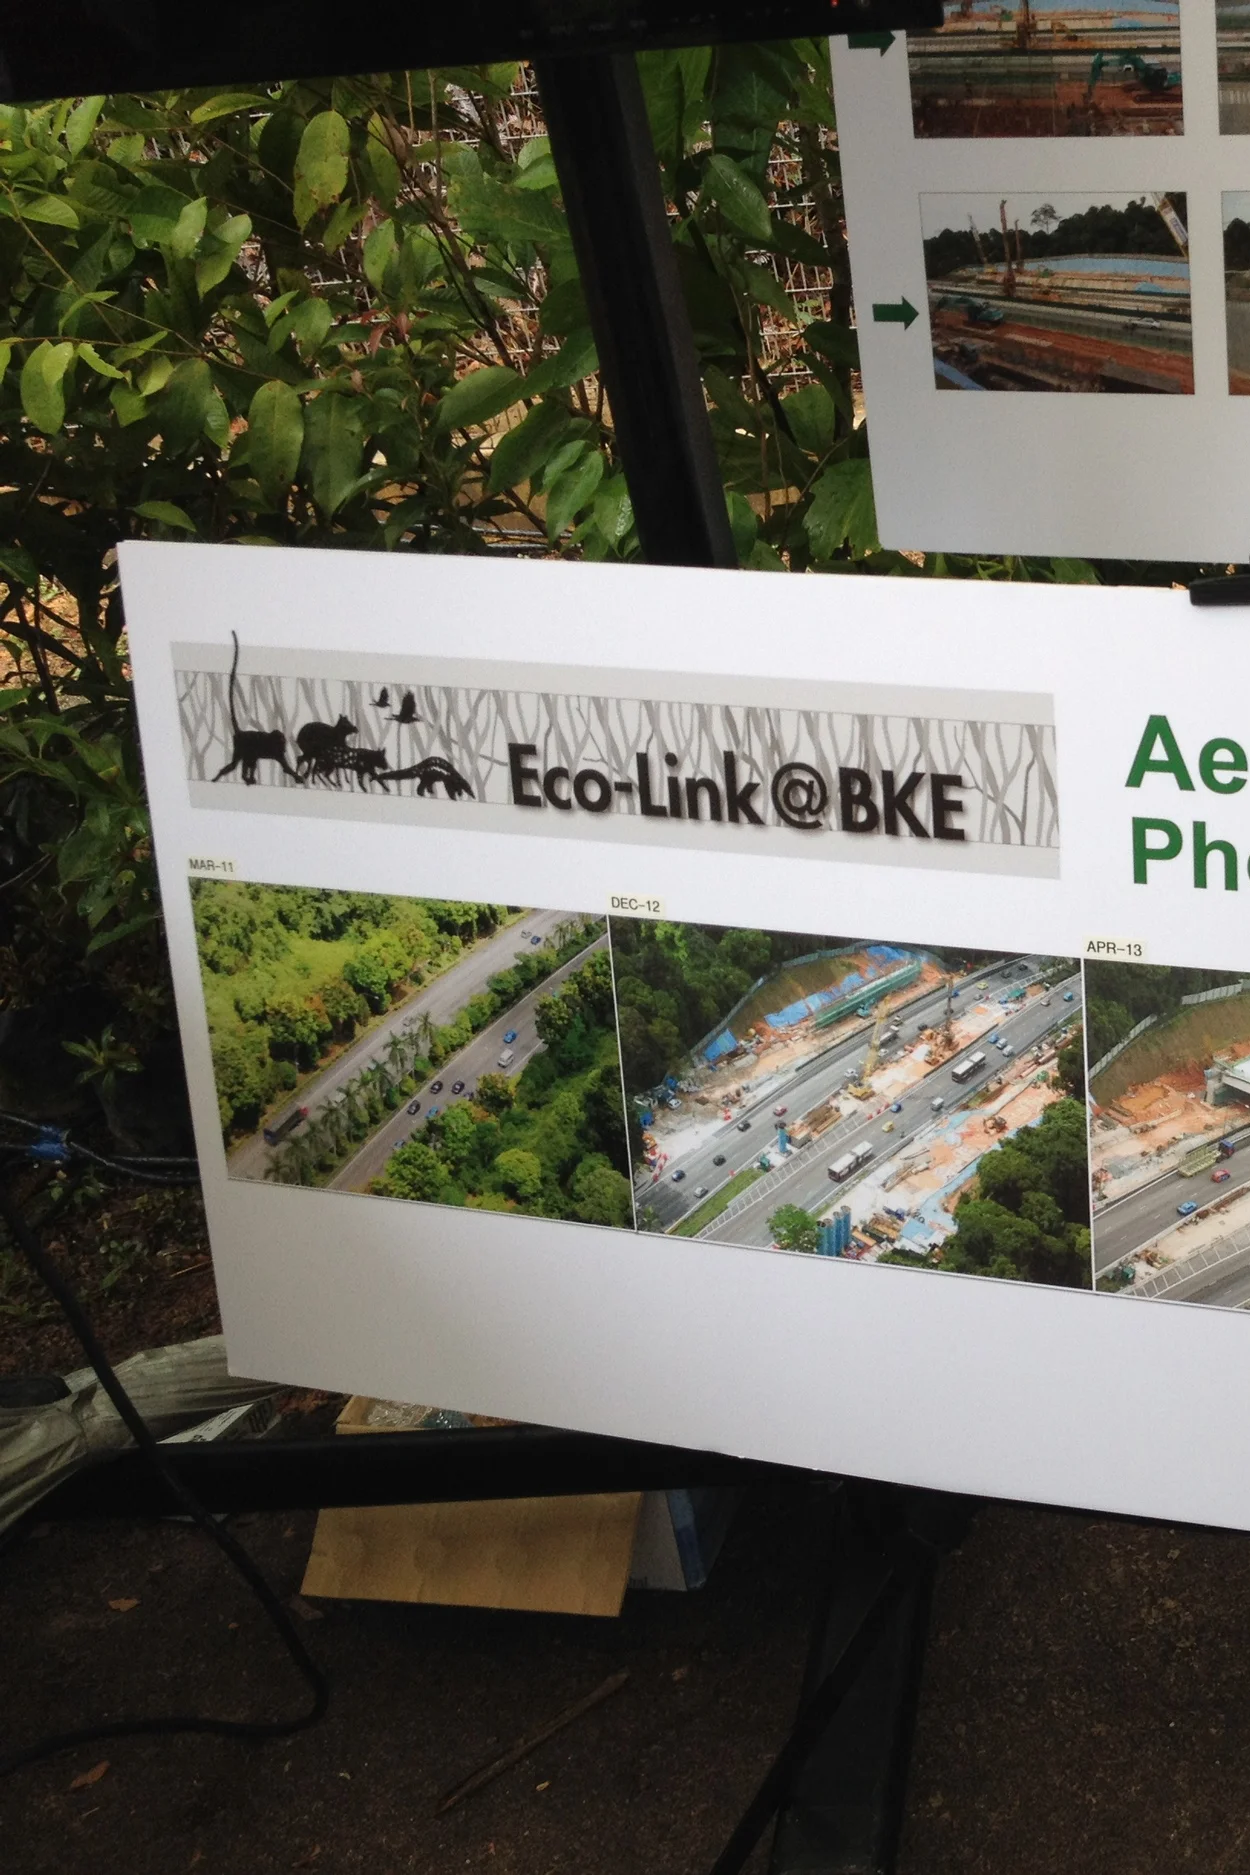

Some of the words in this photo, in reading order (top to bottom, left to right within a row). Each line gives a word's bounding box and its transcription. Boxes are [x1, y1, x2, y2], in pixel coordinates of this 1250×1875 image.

[188, 858, 234, 873] MAR-11
[611, 896, 661, 913] DEC-12
[1086, 940, 1142, 957] APR-13
